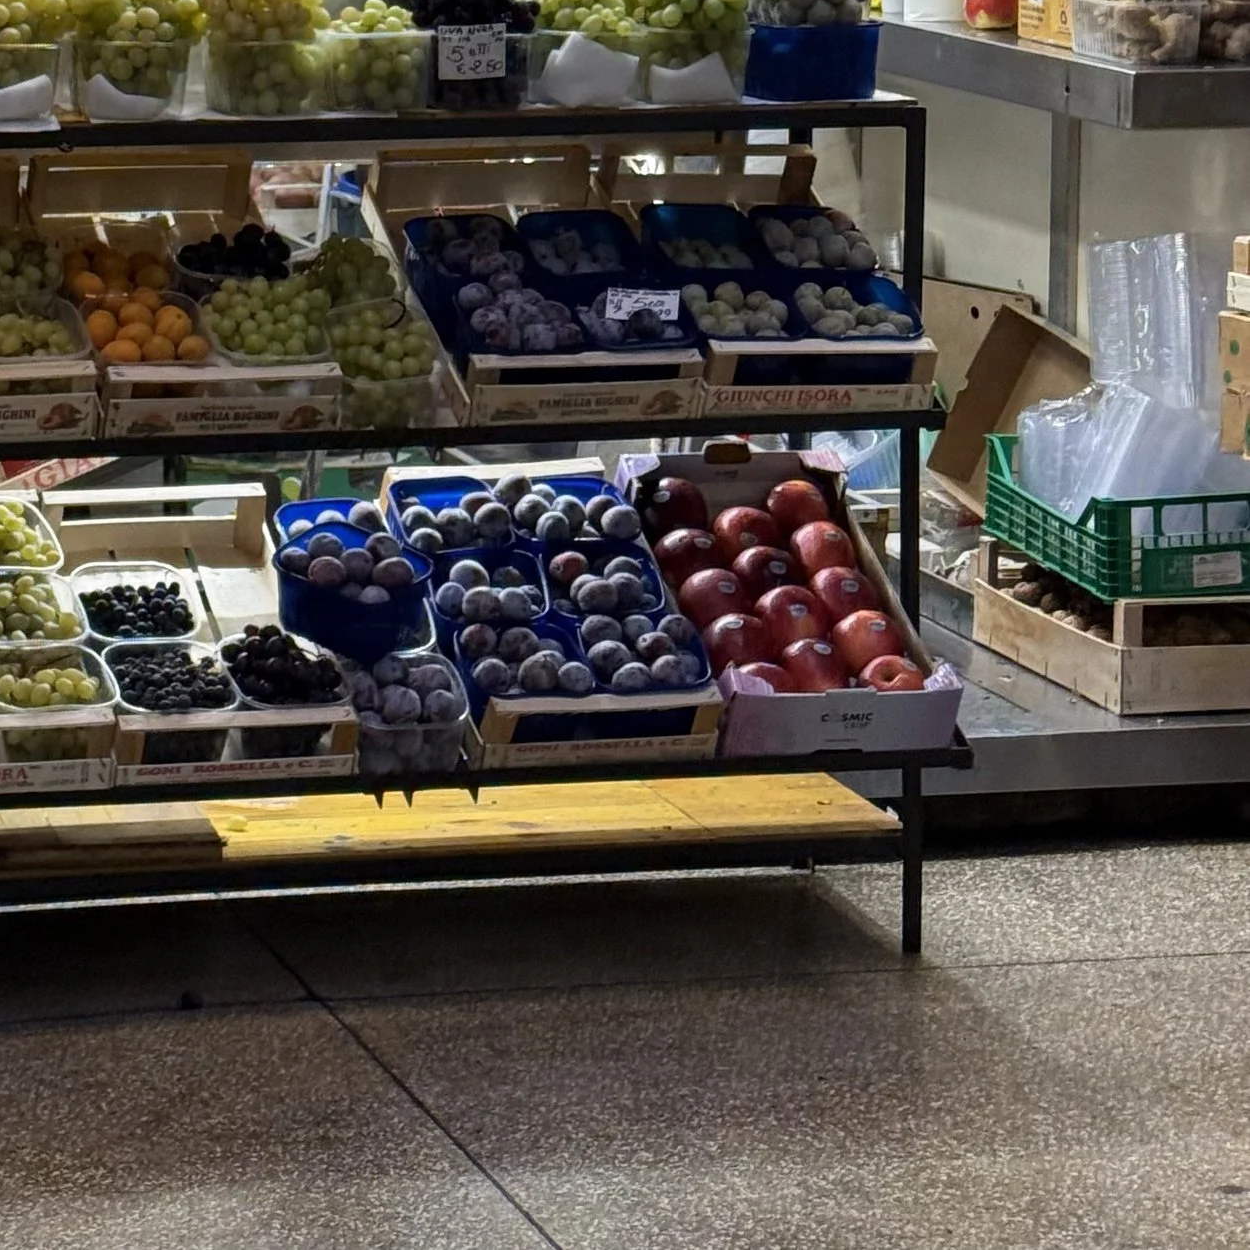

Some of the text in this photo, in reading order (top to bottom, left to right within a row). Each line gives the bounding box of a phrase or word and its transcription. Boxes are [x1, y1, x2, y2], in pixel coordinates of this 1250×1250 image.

[446, 45, 464, 63] 5
[716, 387, 852, 403] GIUNCHI ISORA
